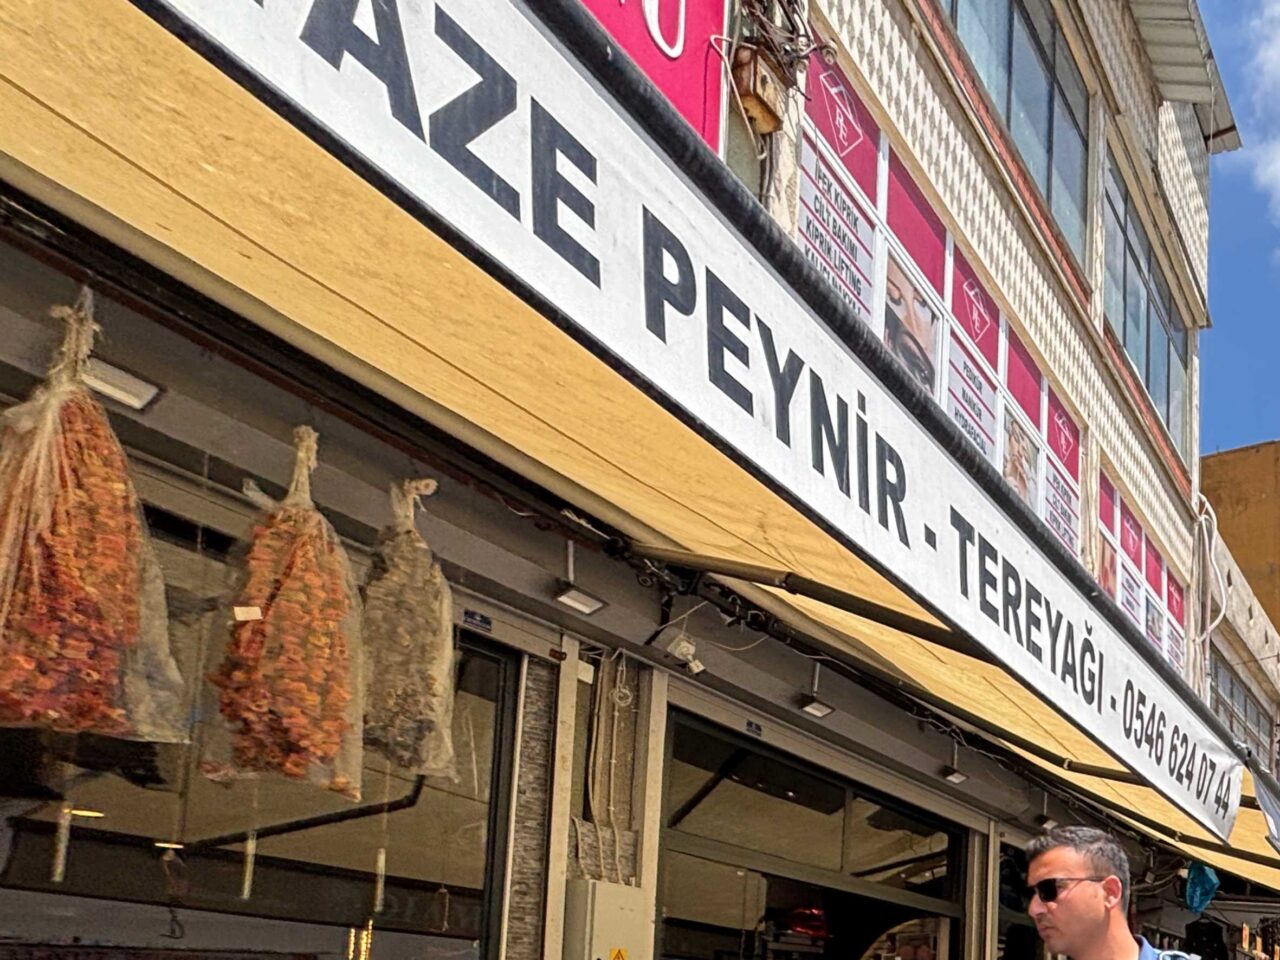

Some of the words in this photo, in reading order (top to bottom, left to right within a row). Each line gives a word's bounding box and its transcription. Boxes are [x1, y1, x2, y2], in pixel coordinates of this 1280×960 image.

[805, 212, 832, 260] KİPRİK
[813, 191, 830, 227] CİLT
[832, 216, 857, 261] BAKIMI
[833, 187, 859, 232] KİPRİK
[252, 0, 601, 290] AZE
[642, 203, 911, 550] PEYNİR
[950, 505, 1105, 715] TEREYAĞI
[1122, 679, 1165, 766] 0546
[1168, 724, 1195, 793] 624
[1196, 752, 1217, 806] 07
[1214, 772, 1232, 820] 44
